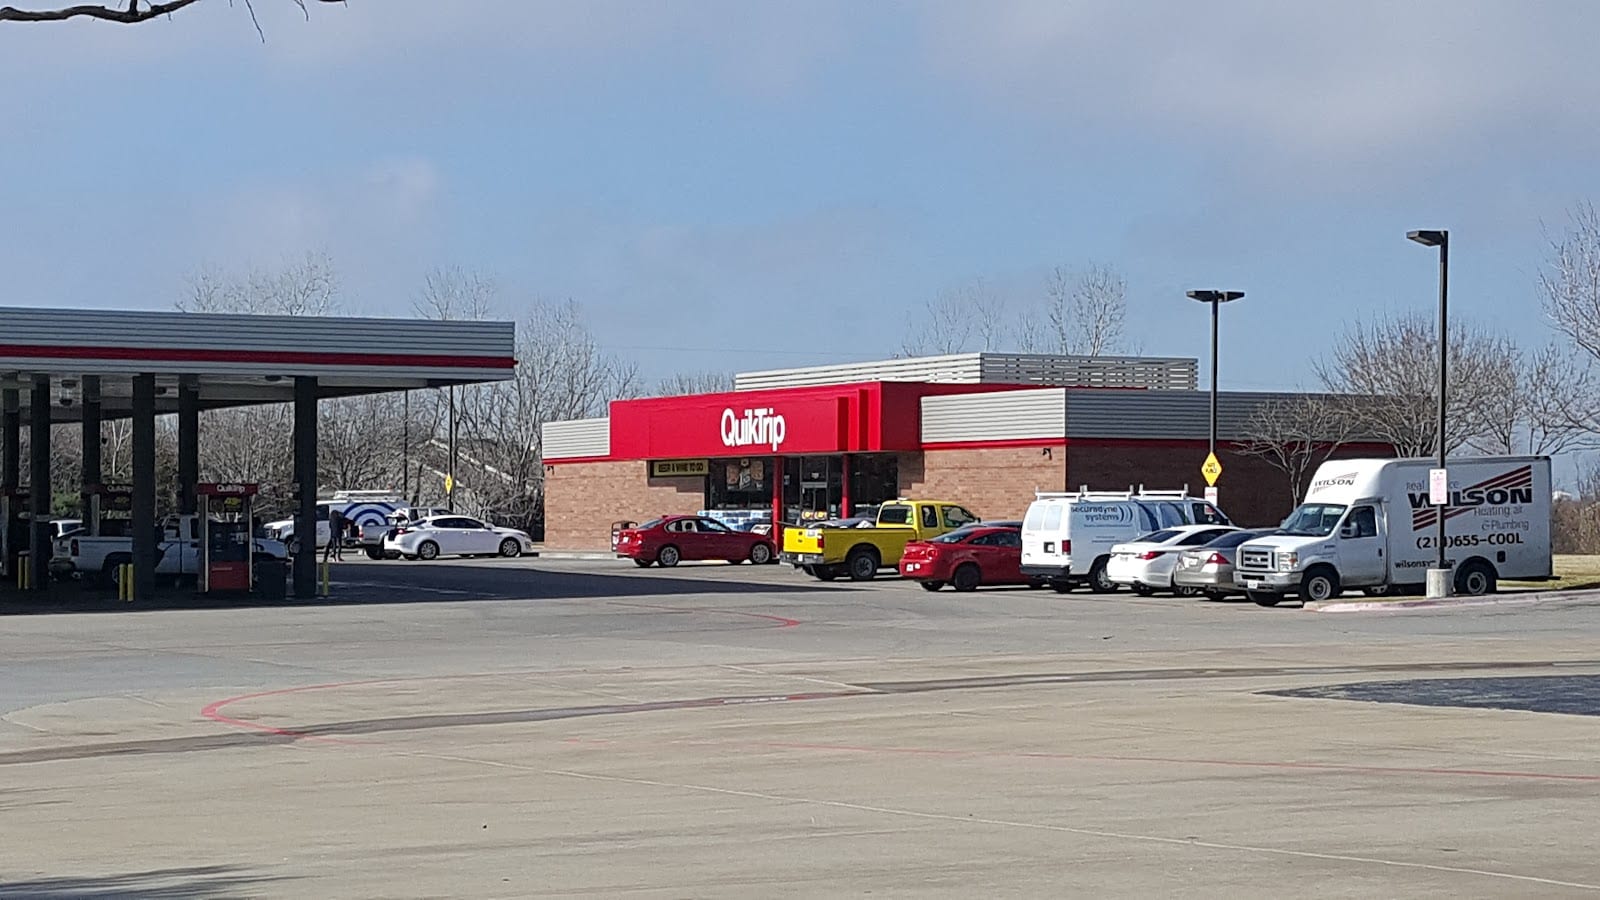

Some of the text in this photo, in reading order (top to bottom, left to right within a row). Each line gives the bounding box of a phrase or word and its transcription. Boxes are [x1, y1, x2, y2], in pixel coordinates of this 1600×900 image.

[721, 408, 785, 452] QuikTrip
[1408, 488, 1532, 508] WILSON
[1085, 513, 1119, 522] systems
[1474, 506, 1511, 518] Heating
